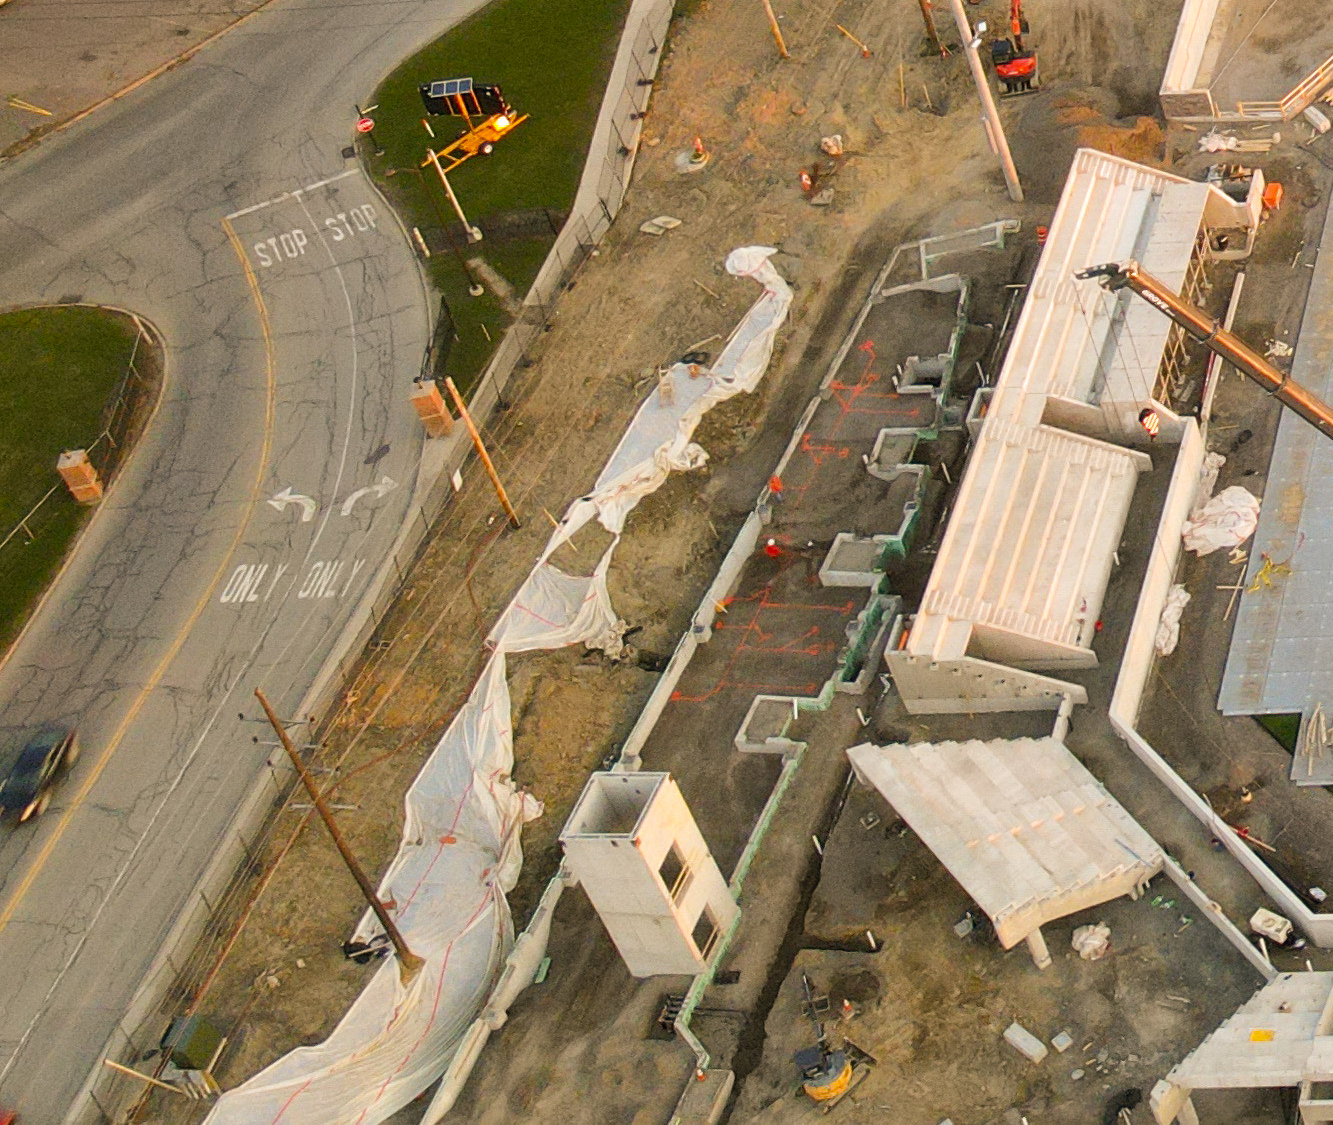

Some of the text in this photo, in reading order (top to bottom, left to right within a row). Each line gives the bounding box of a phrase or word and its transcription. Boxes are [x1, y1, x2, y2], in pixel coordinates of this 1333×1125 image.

[325, 203, 377, 241] STOP
[254, 229, 308, 267] STOP
[1141, 289, 1169, 310] GROVE
[220, 563, 290, 603] ONLY
[298, 558, 366, 598] ONLY
